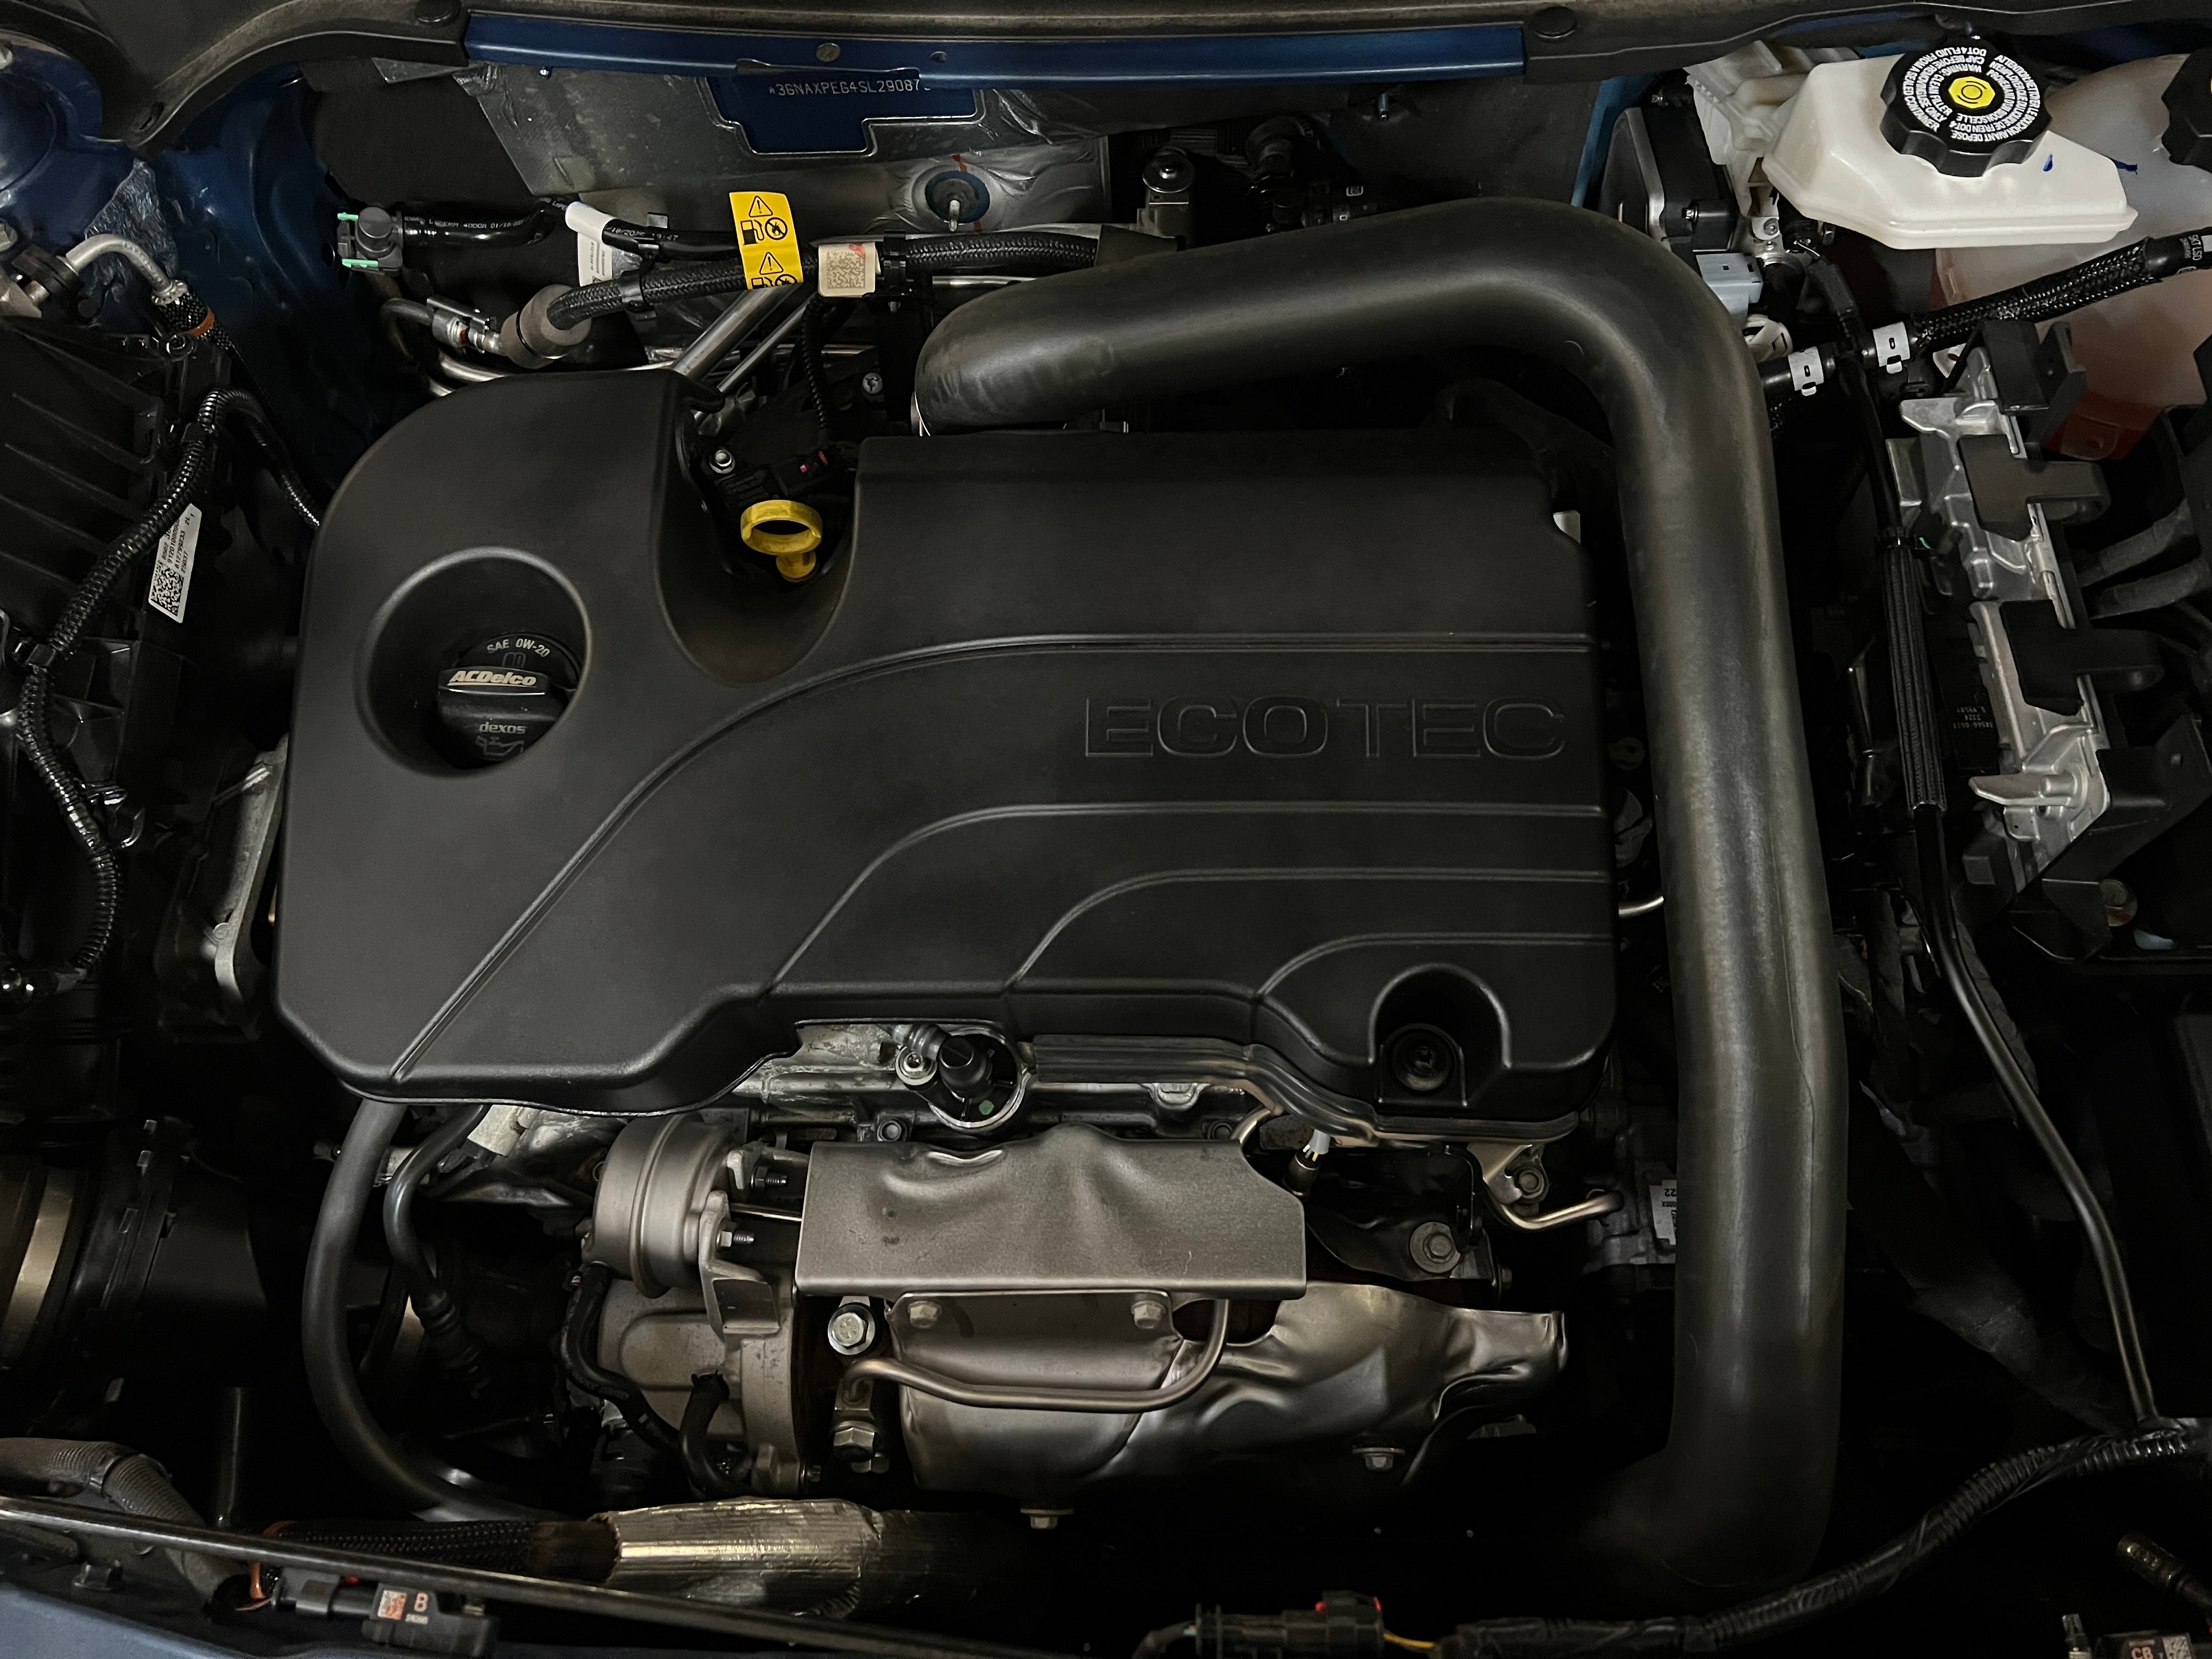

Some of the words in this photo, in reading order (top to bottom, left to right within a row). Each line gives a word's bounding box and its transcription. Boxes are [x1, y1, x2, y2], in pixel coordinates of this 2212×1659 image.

[1935, 47, 1961, 57] FLUID
[1967, 47, 1987, 56] DOT
[1914, 53, 1937, 69] FROM
[1932, 55, 1966, 69] BEFORE
[1966, 55, 1985, 65] CAP
[1903, 71, 1918, 95] SEALED
[1928, 74, 1945, 94] CLEAN
[1918, 97, 1932, 109] USE
[1931, 95, 1953, 117] FILLER
[1904, 95, 1940, 132] CONTAINER
[1925, 106, 1948, 123] ONLY
[2028, 108, 2039, 117] LE
[1955, 123, 1972, 133] DOT
[1972, 124, 1996, 133] FREIN
[1993, 121, 2006, 131] DE
[2008, 116, 2035, 137] BOUCHON
[1984, 130, 2009, 142] AVANT
[487, 639, 509, 654] SAE
[516, 638, 550, 658] 0W-20
[449, 670, 537, 686] ACDelco
[478, 721, 527, 735] dexos
[1084, 696, 1566, 760] ECOTEC
